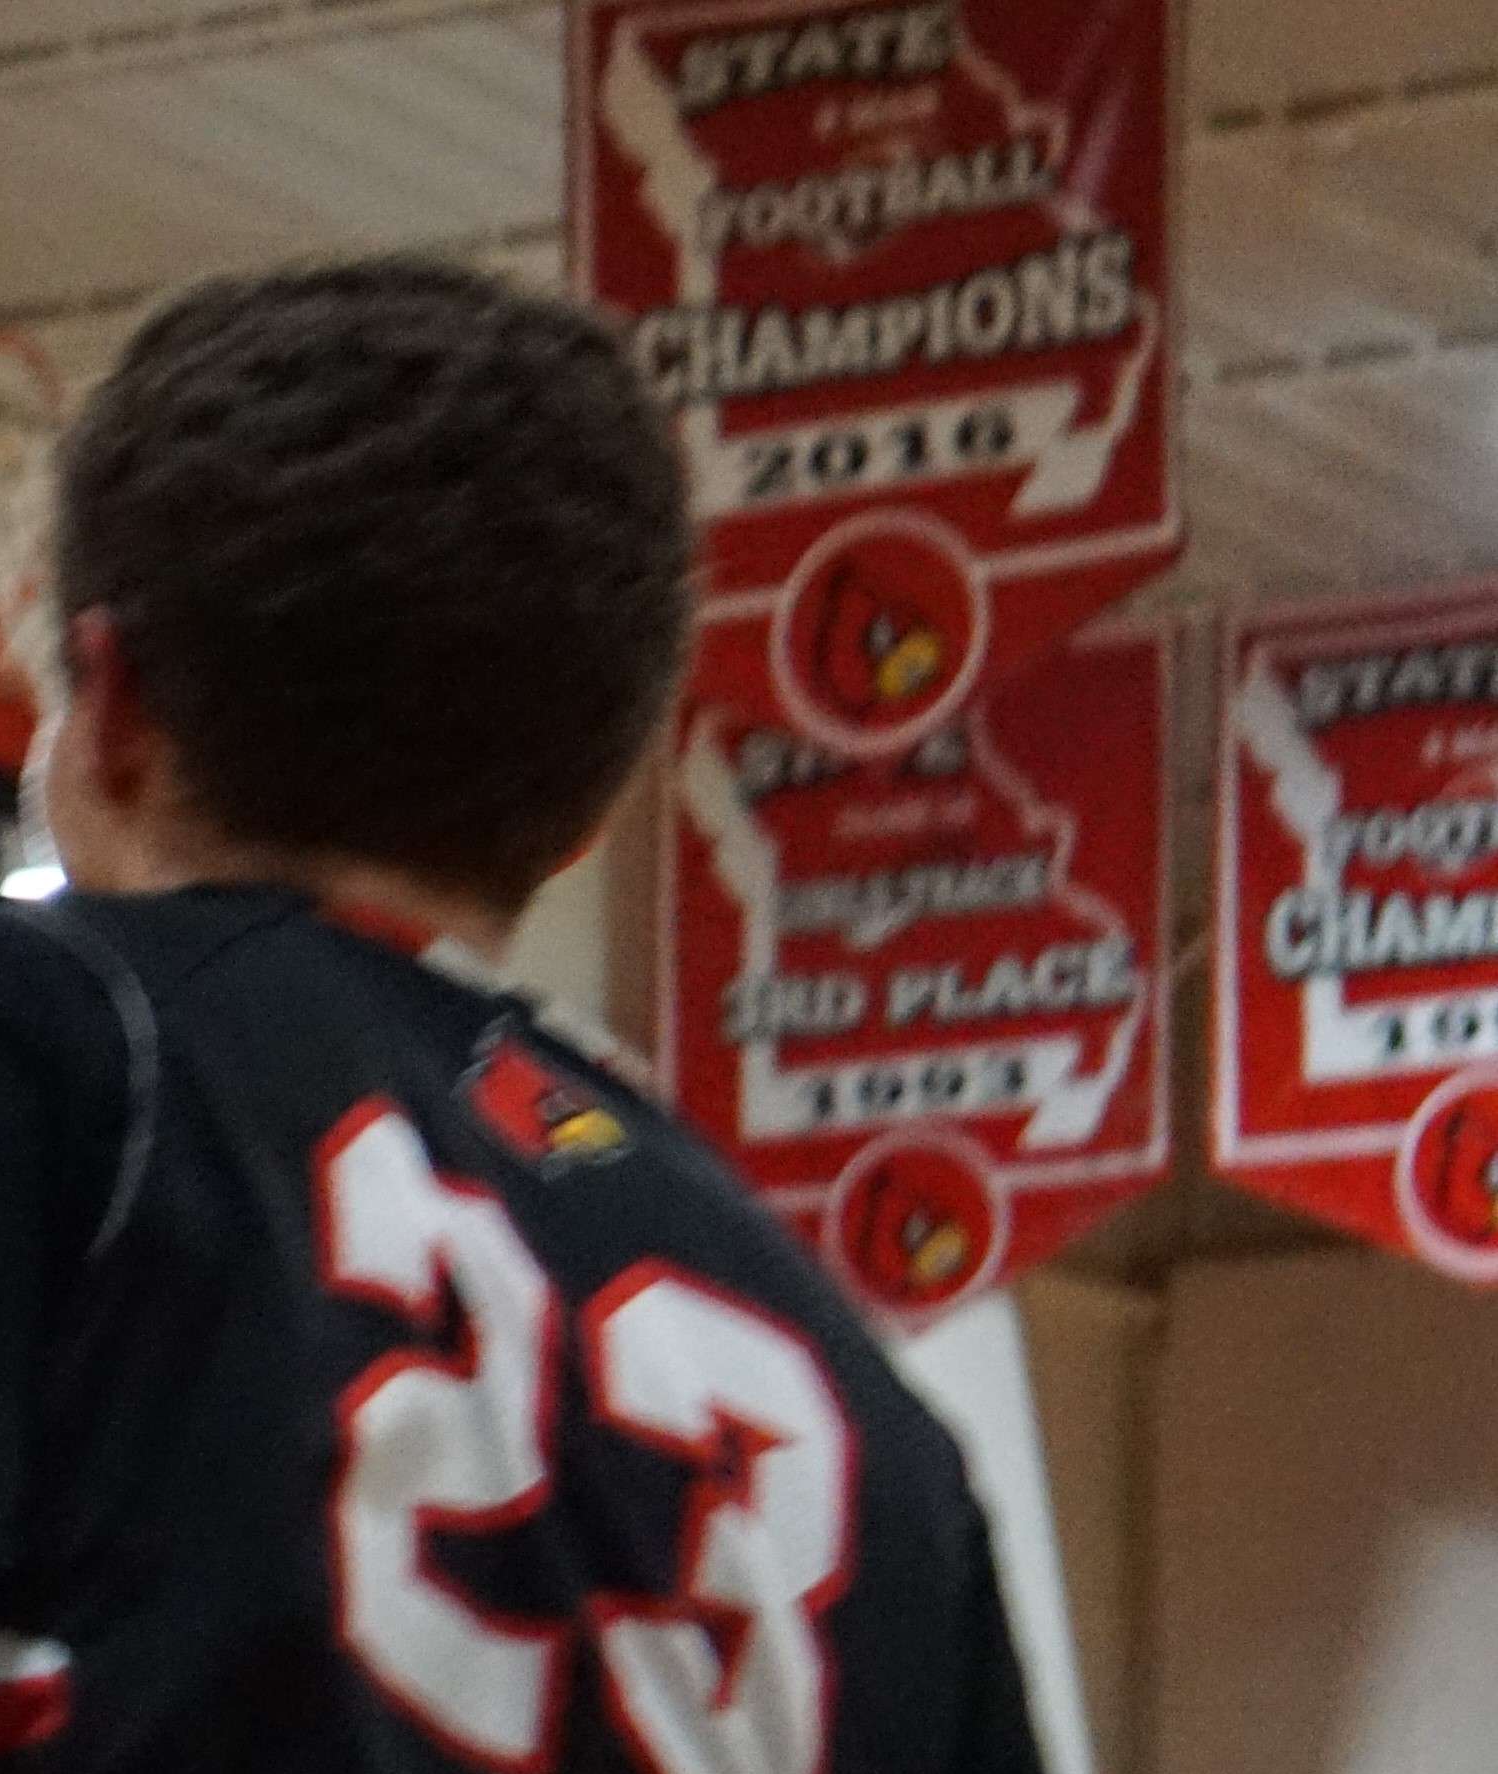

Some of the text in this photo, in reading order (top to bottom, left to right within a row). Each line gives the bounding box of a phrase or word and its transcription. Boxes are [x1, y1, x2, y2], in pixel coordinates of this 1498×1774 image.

[679, 2, 961, 116] STATE
[696, 134, 1062, 256] FOOTBALL
[631, 224, 1134, 405] CHAMPIONS
[742, 406, 1016, 498] 2016
[1296, 646, 1498, 732] STAT
[1322, 800, 1498, 872] FOOT
[885, 934, 1136, 1026] PLACE
[1264, 884, 1498, 984] CHAM
